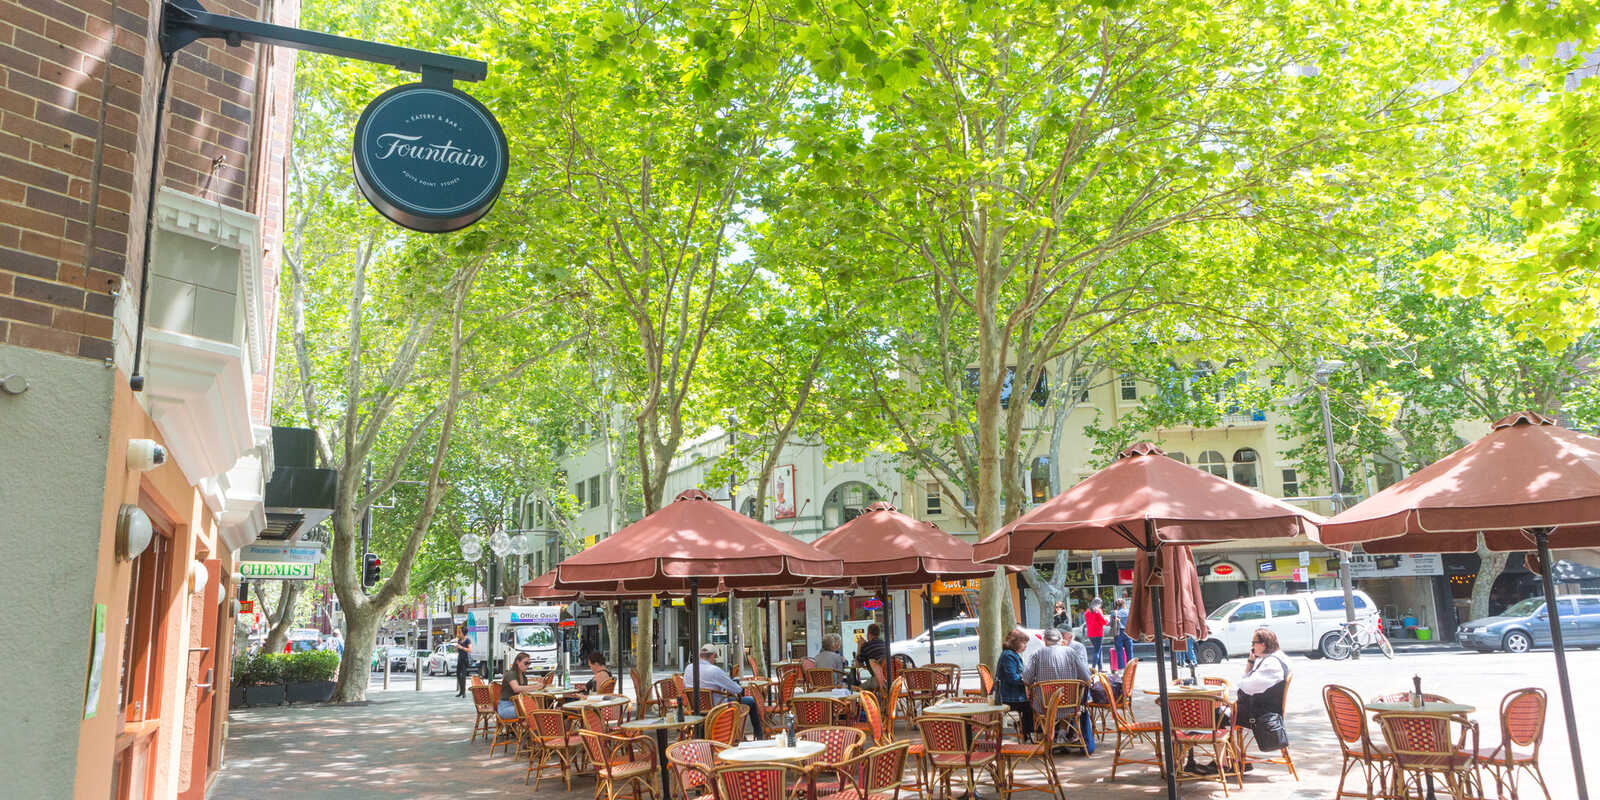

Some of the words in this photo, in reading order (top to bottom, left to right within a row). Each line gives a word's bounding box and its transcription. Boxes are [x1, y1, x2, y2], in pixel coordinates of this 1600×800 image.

[410, 113, 435, 121] EATERY
[445, 118, 458, 127] BAR
[376, 133, 487, 168] Fountain
[240, 563, 312, 577] CHEMIST
